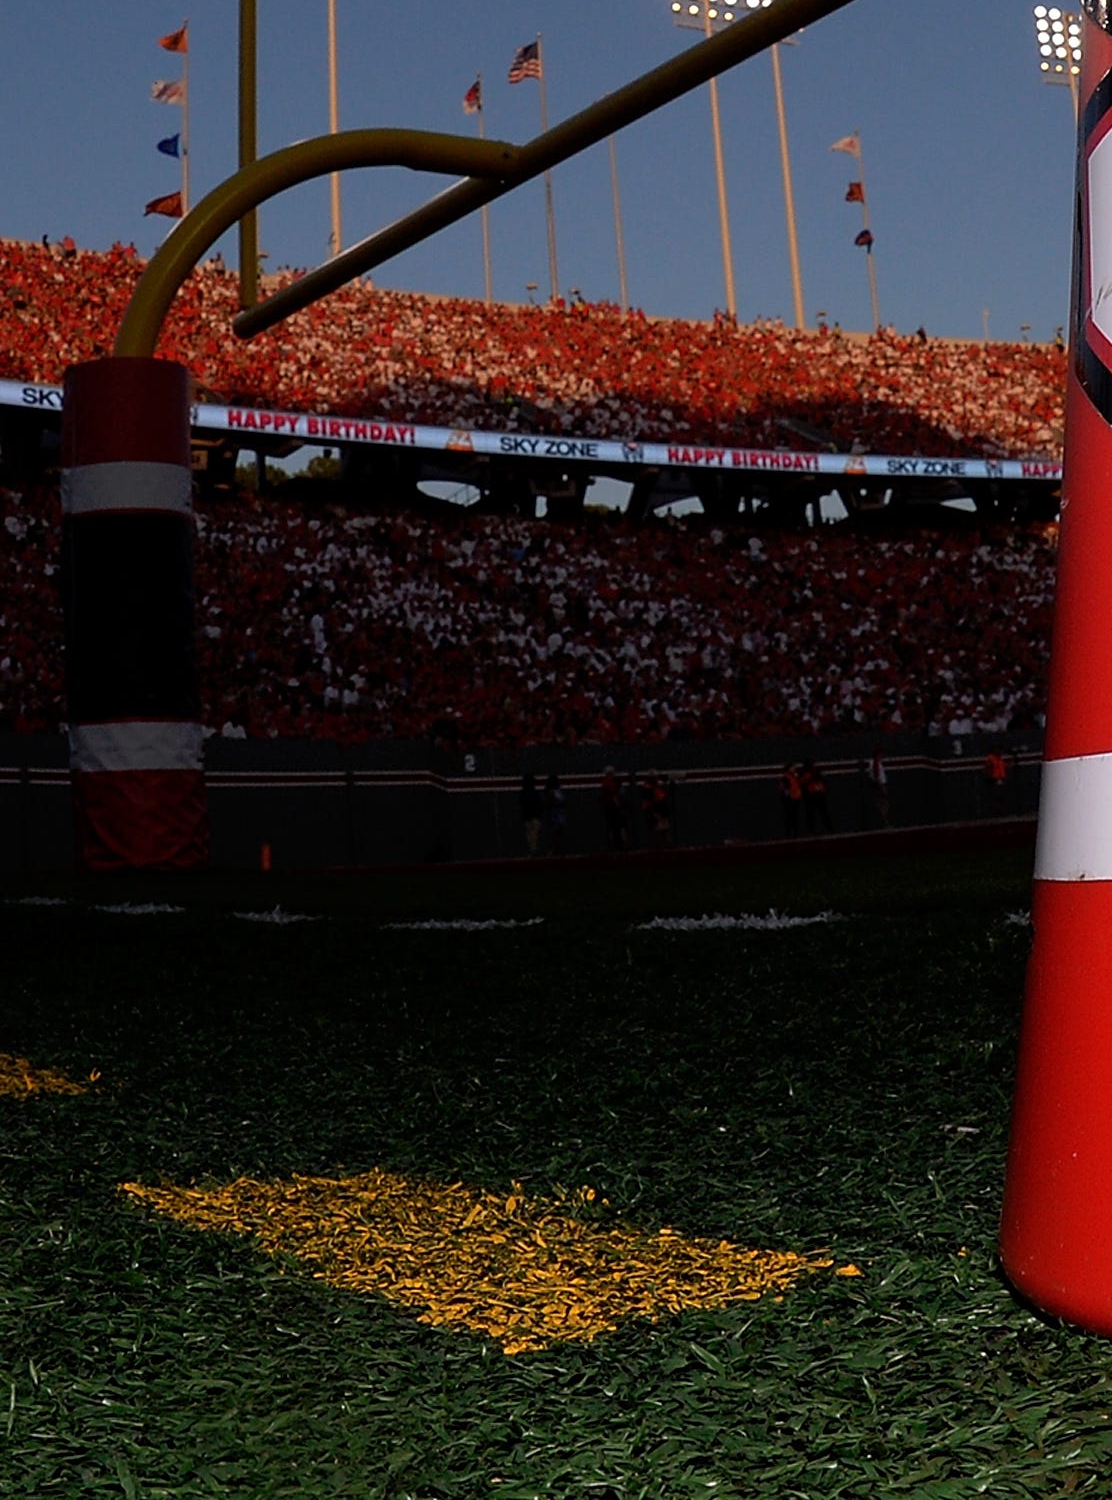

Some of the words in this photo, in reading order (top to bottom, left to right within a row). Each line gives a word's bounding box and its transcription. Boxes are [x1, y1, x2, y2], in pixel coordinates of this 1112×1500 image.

[227, 409, 299, 432] HAPPY
[308, 417, 416, 445] BIRTHDAY!
[500, 437, 539, 453] SKY
[545, 441, 598, 458] ZONE
[668, 447, 725, 467] HAPPY
[732, 451, 819, 471] BIRTHDAY!
[887, 459, 919, 474] SKY
[924, 461, 965, 476] ZONE
[1022, 462, 1059, 477] HAPP
